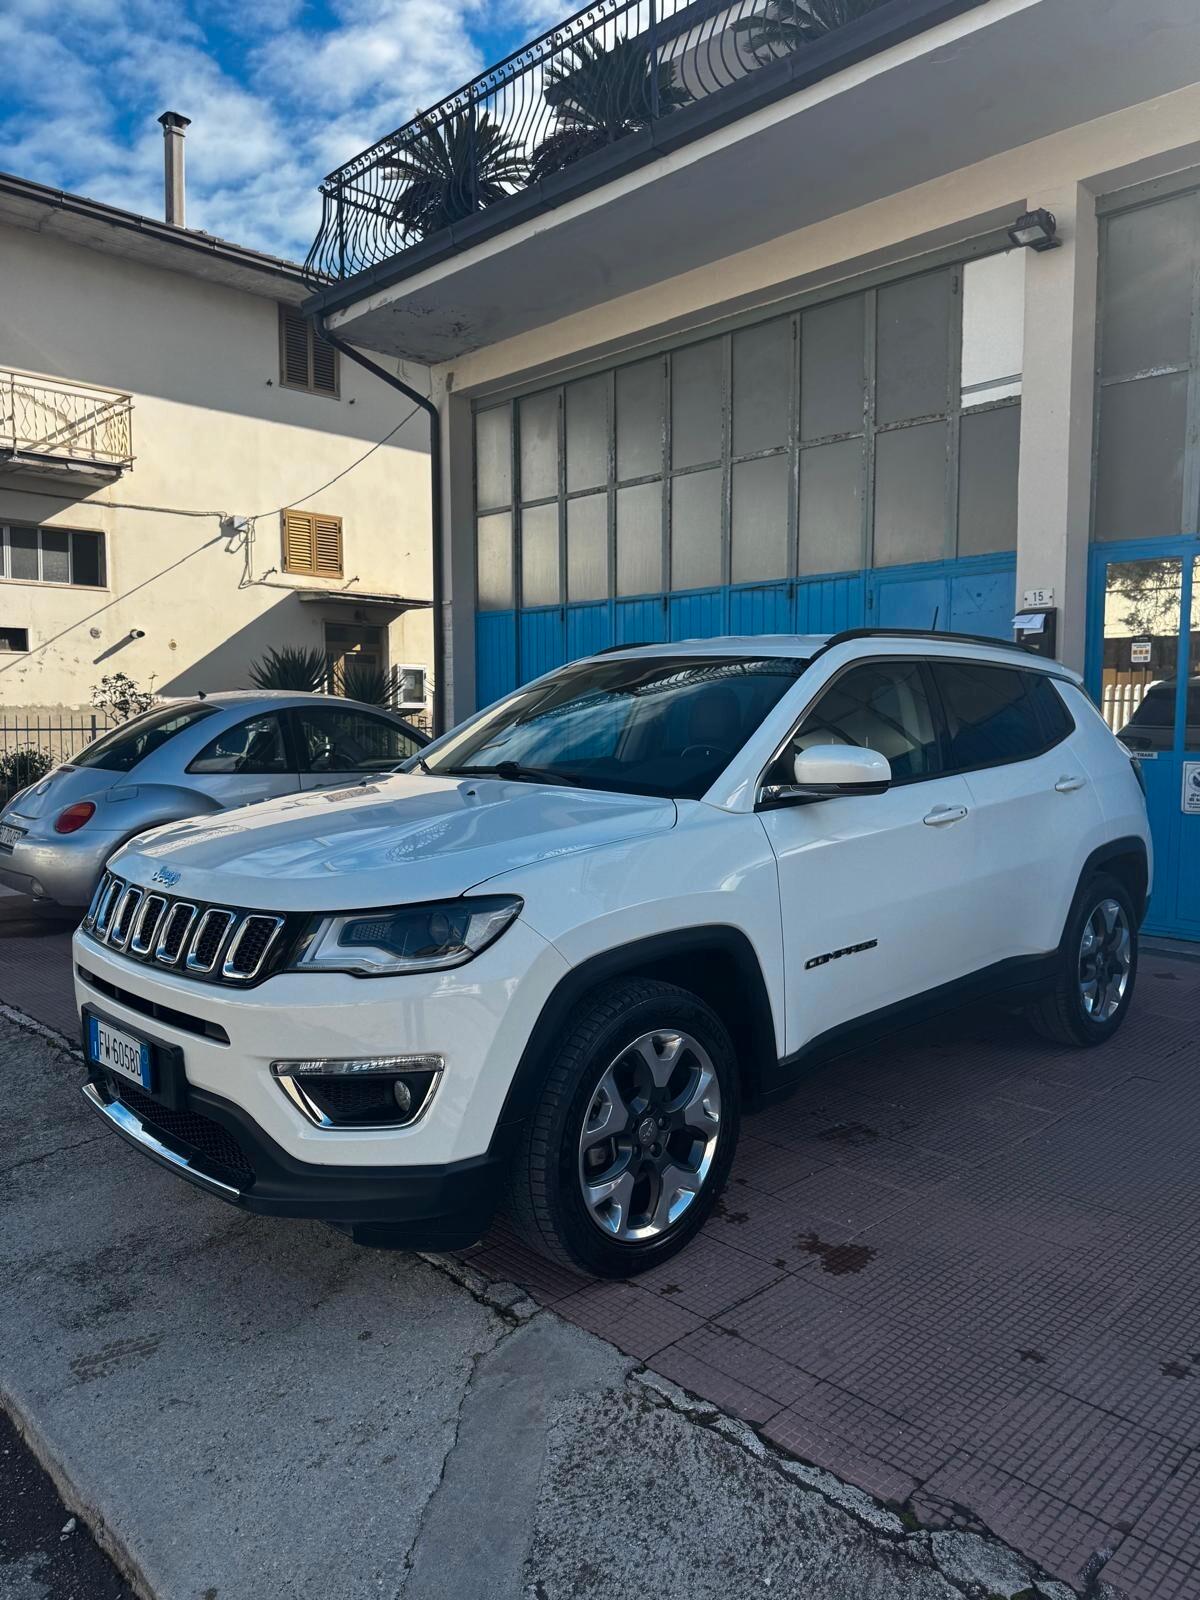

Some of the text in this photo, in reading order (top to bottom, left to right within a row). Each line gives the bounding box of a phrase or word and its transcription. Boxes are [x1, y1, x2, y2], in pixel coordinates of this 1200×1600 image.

[1032, 591, 1044, 602] 15
[152, 866, 182, 888] Jeep
[804, 938, 878, 970] COMPASS
